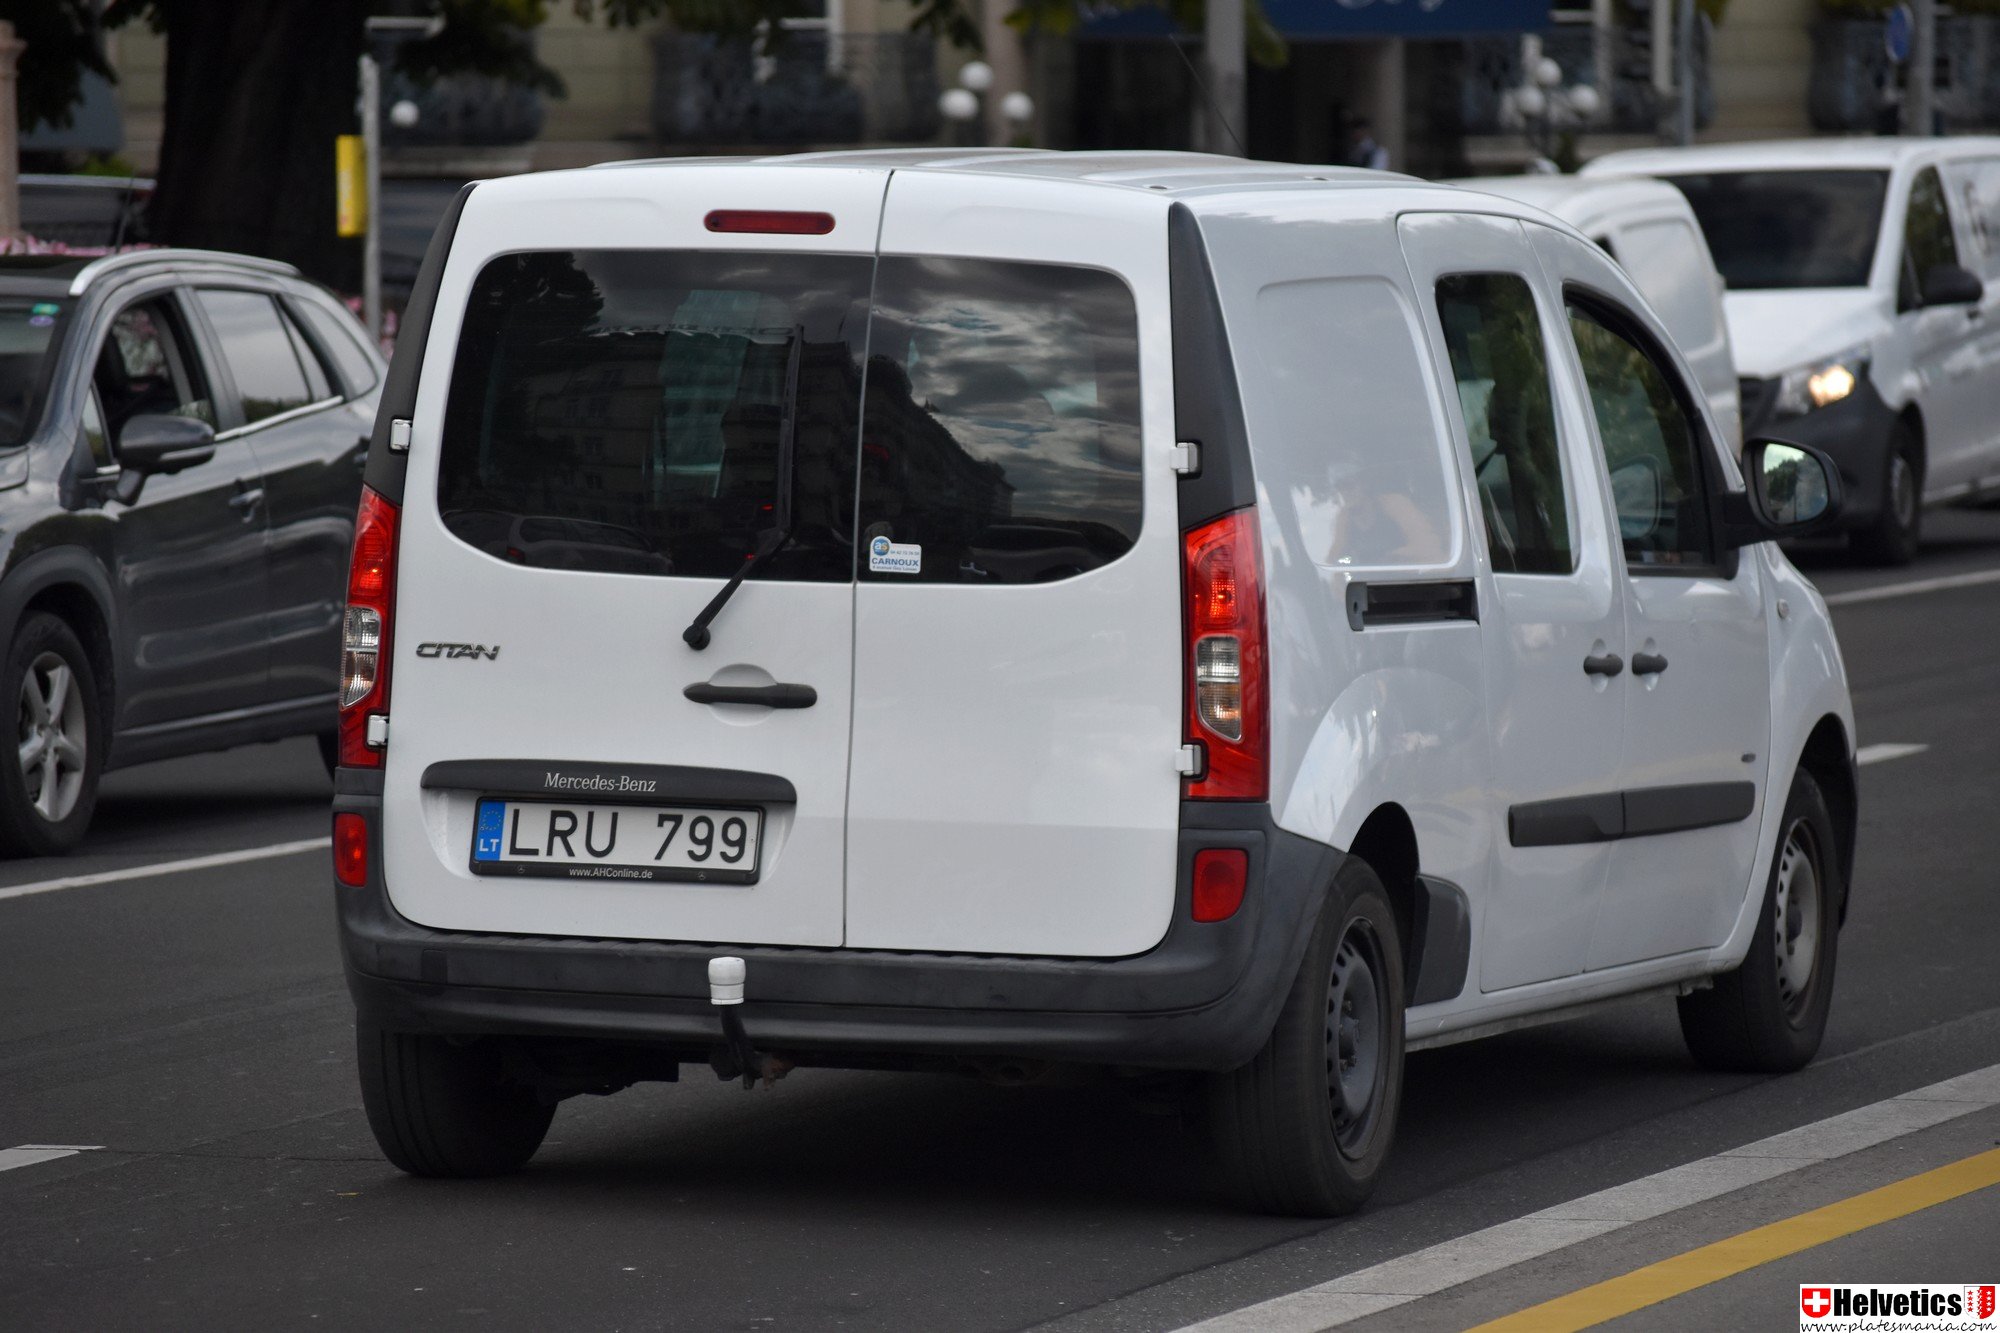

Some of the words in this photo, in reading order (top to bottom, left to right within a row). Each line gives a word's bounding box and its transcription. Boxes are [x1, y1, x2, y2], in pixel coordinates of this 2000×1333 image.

[871, 557, 919, 566] CARNOUX
[416, 643, 500, 660] CITAN
[544, 772, 656, 792] Mercedes-Benz
[509, 808, 619, 858] LRU
[654, 813, 747, 863] 799
[479, 838, 499, 853] LT
[569, 868, 653, 879] www.AHConline.de
